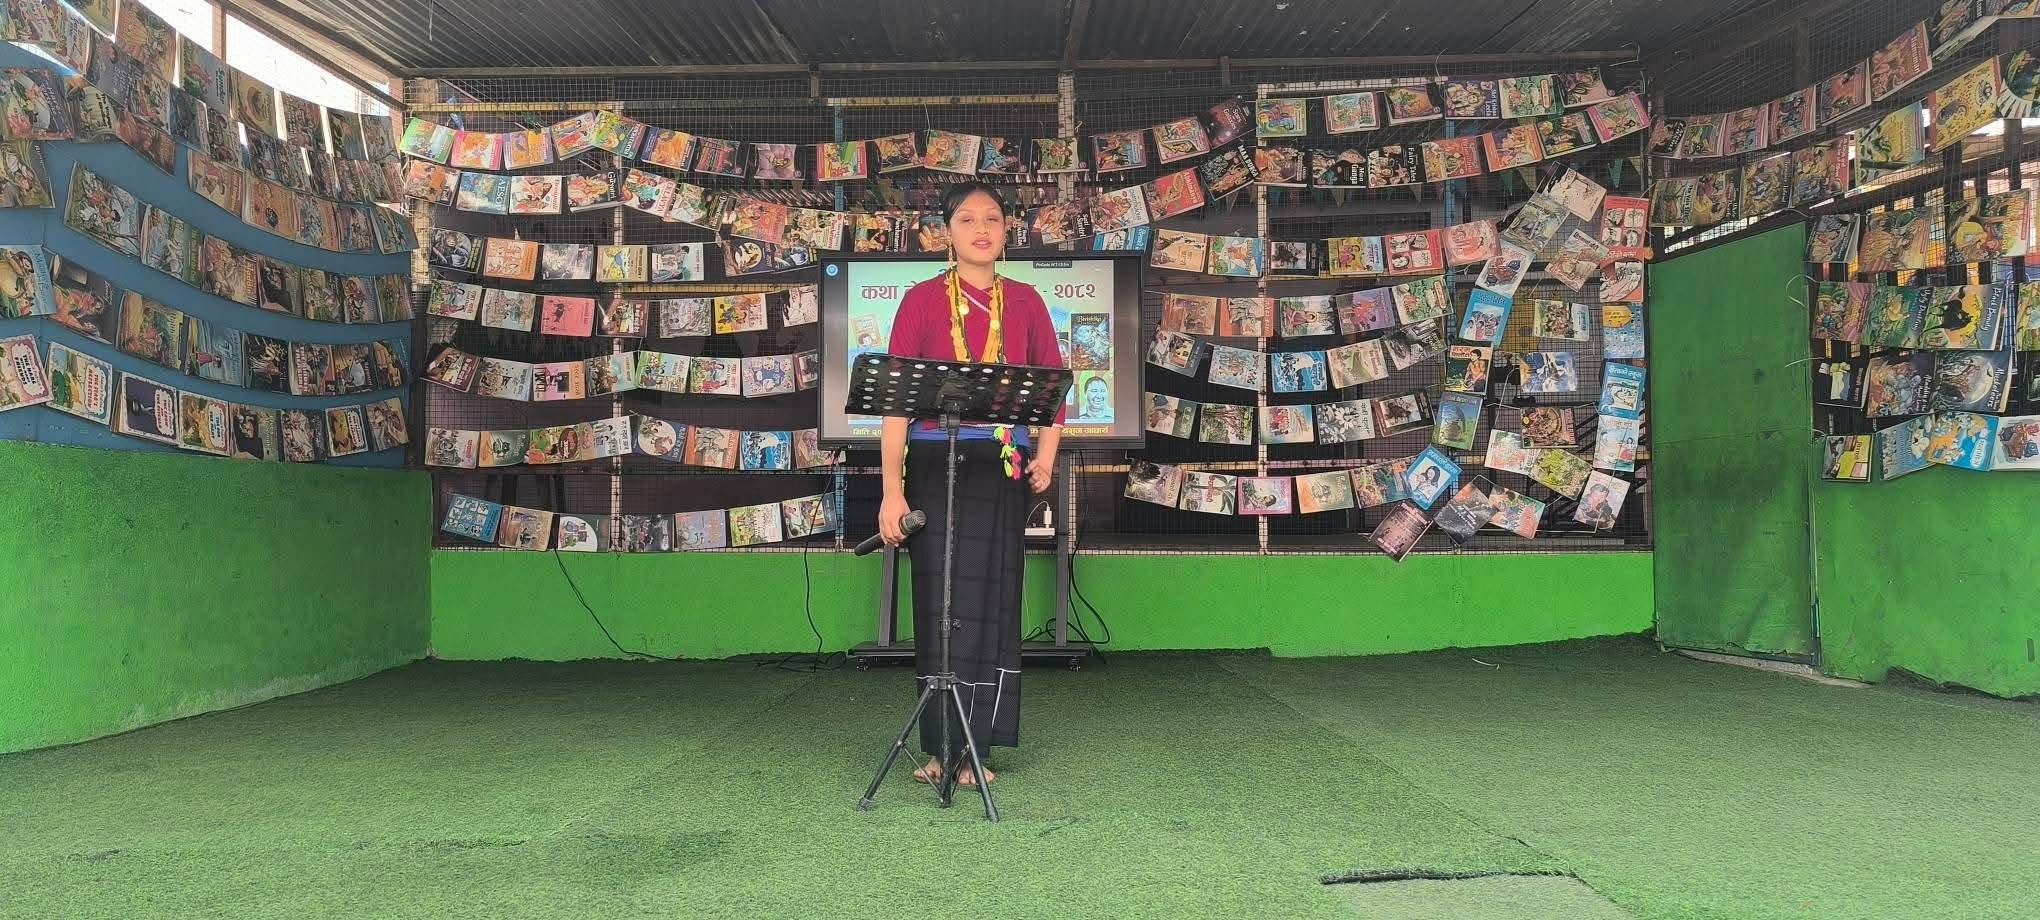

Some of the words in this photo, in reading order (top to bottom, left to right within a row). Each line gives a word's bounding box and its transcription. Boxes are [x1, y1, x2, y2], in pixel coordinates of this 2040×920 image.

[1408, 147, 1416, 165] Fairy
[1350, 164, 1359, 184] Ganga
[495, 177, 507, 210] AESOP
[862, 285, 899, 299] कथा
[1054, 283, 1096, 298] २०८२
[1991, 287, 2002, 306] Black
[15, 357, 28, 386] FRIENDS
[22, 354, 32, 366] THE
[27, 367, 37, 384] HARE
